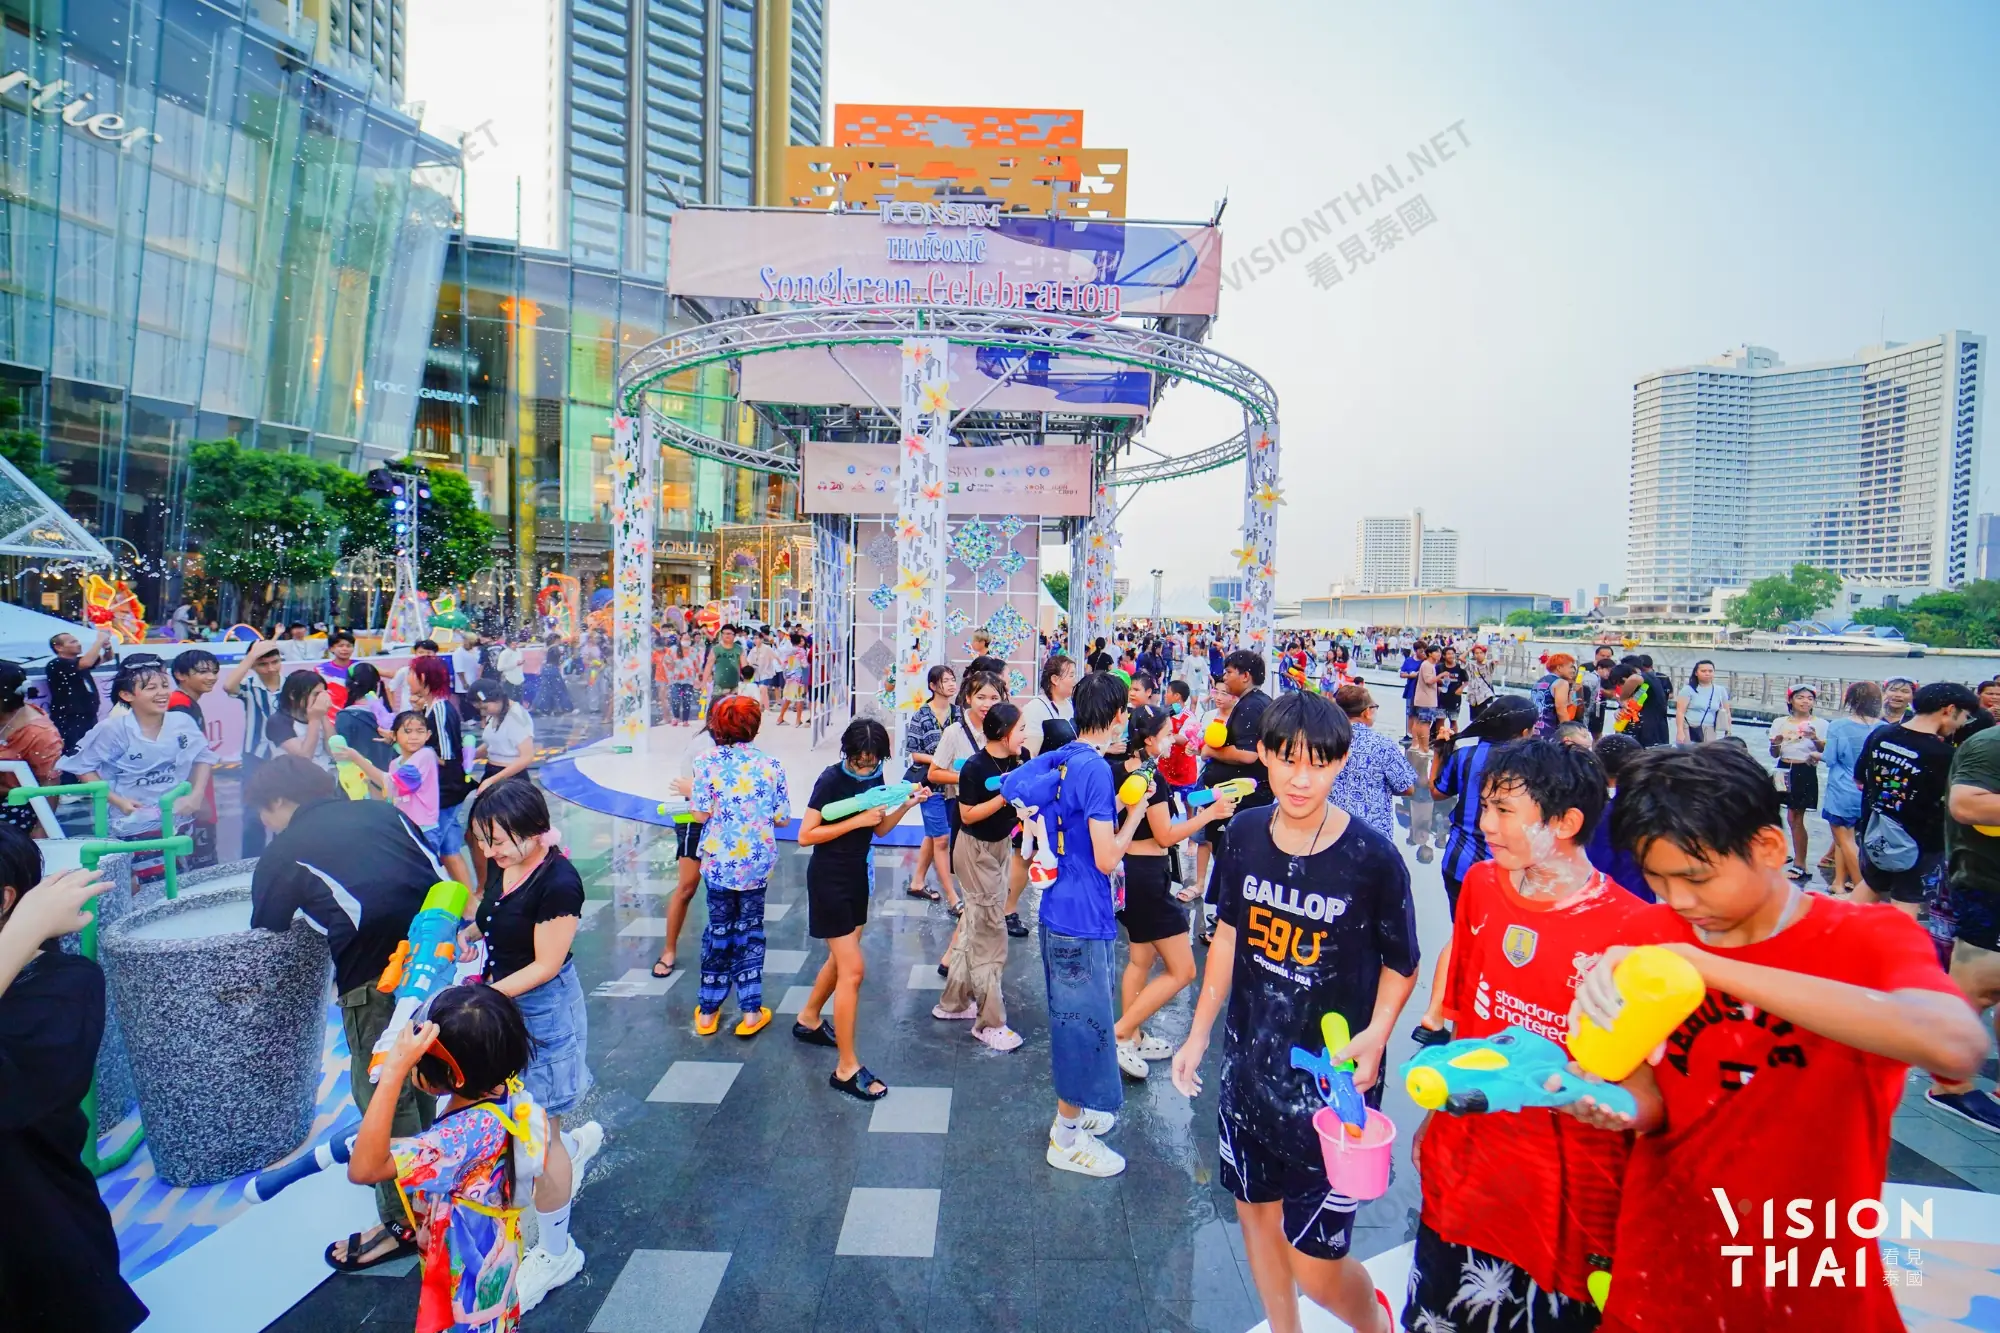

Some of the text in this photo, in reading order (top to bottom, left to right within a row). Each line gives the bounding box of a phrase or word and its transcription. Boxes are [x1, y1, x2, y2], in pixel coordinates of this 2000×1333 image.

[759, 266, 1122, 314] Songkran Celebration
[1243, 874, 1346, 924] GALLOP
[1294, 973, 1312, 987] USA
[1495, 990, 1568, 1028] standard
